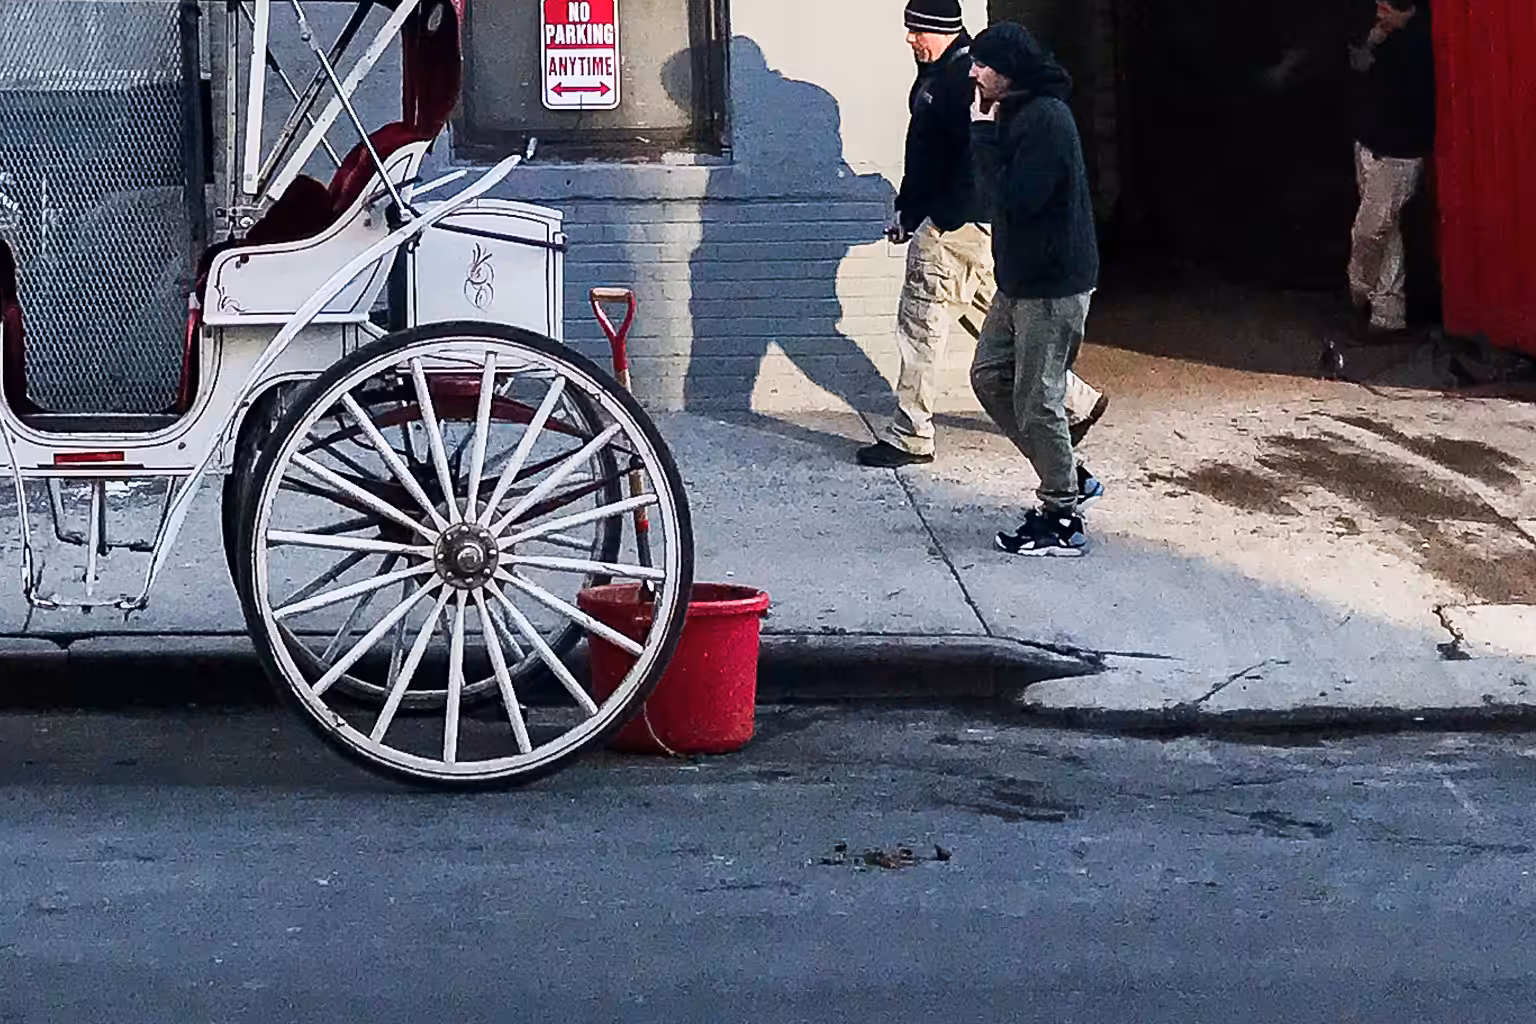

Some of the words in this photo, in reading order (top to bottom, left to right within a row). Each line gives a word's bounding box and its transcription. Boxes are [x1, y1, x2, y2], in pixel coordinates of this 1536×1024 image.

[567, 1, 591, 23] NO
[545, 23, 615, 45] PARKING
[548, 56, 613, 77] ANYTIME
